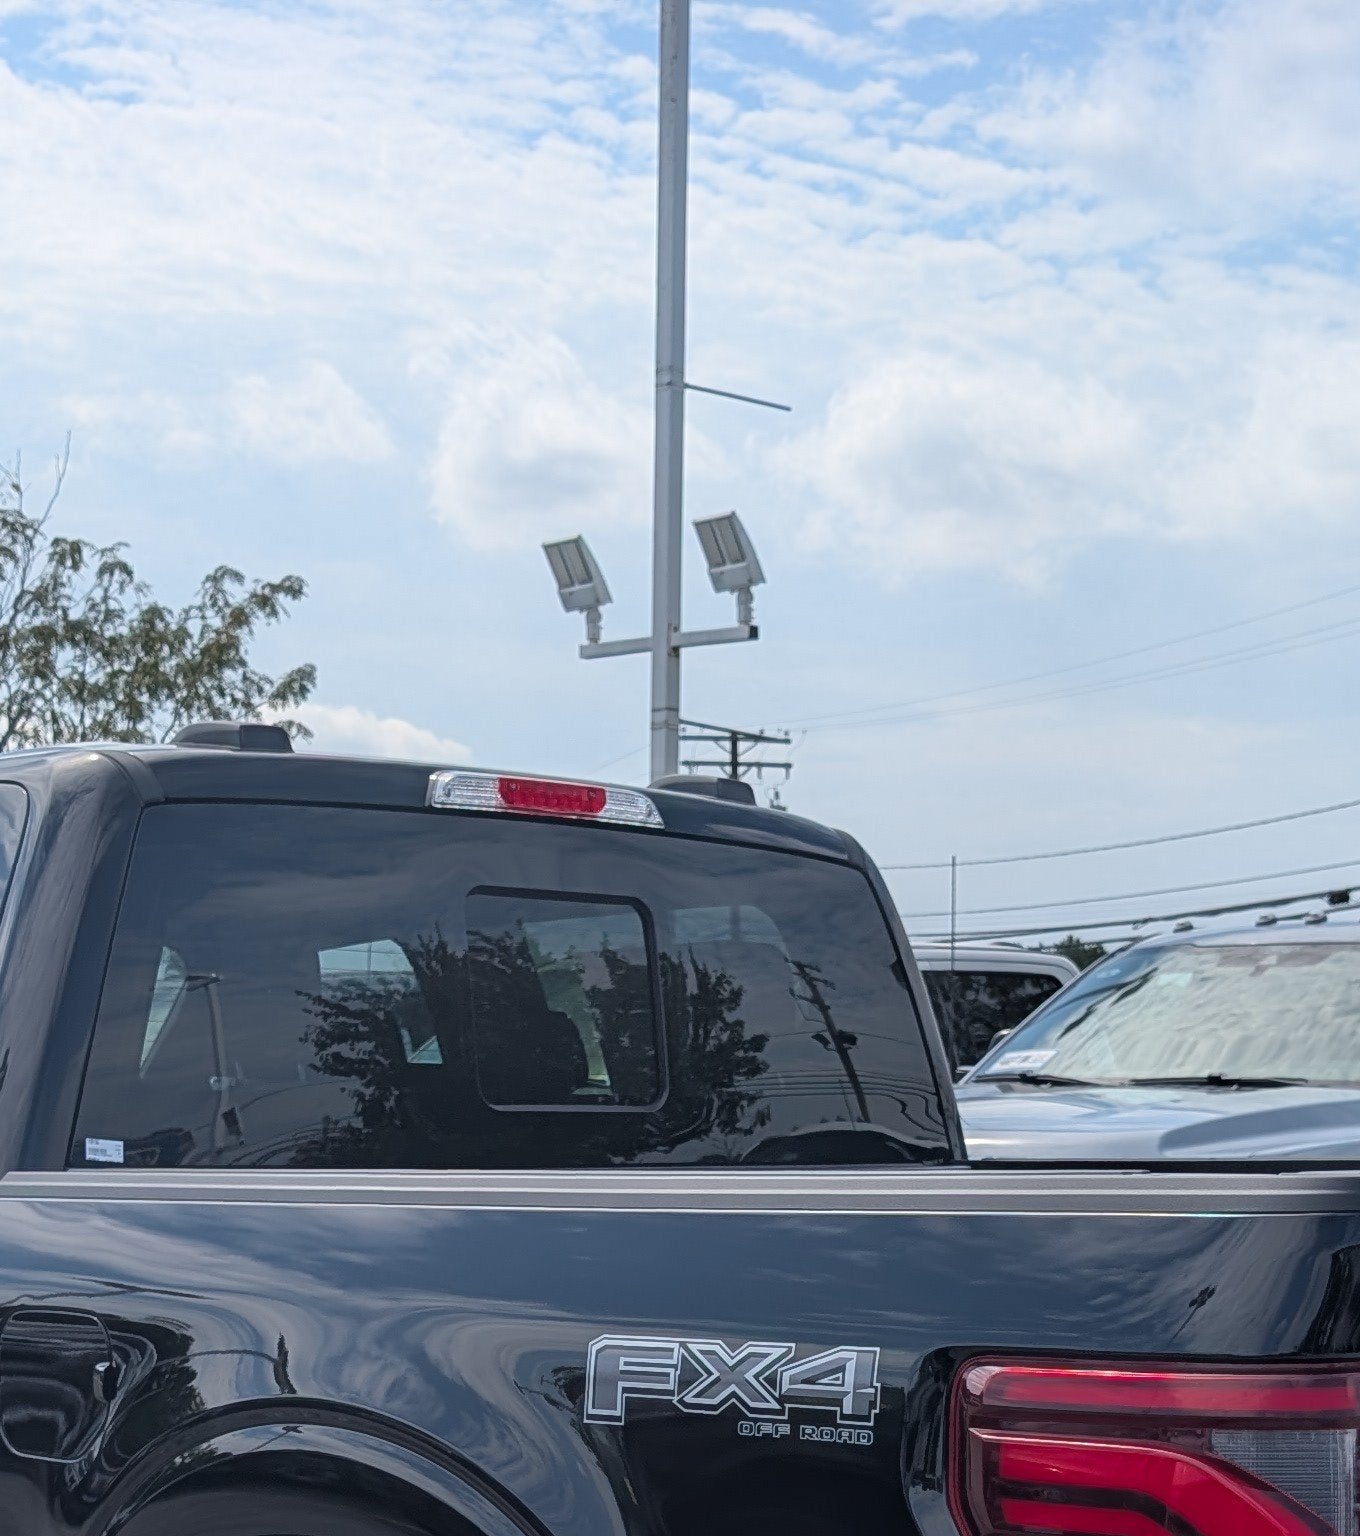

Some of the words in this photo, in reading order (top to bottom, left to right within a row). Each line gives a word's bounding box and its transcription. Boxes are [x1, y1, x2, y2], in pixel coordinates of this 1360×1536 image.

[583, 1334, 881, 1426] FX4
[737, 1420, 791, 1438] OFF
[799, 1425, 874, 1446] ROAD
